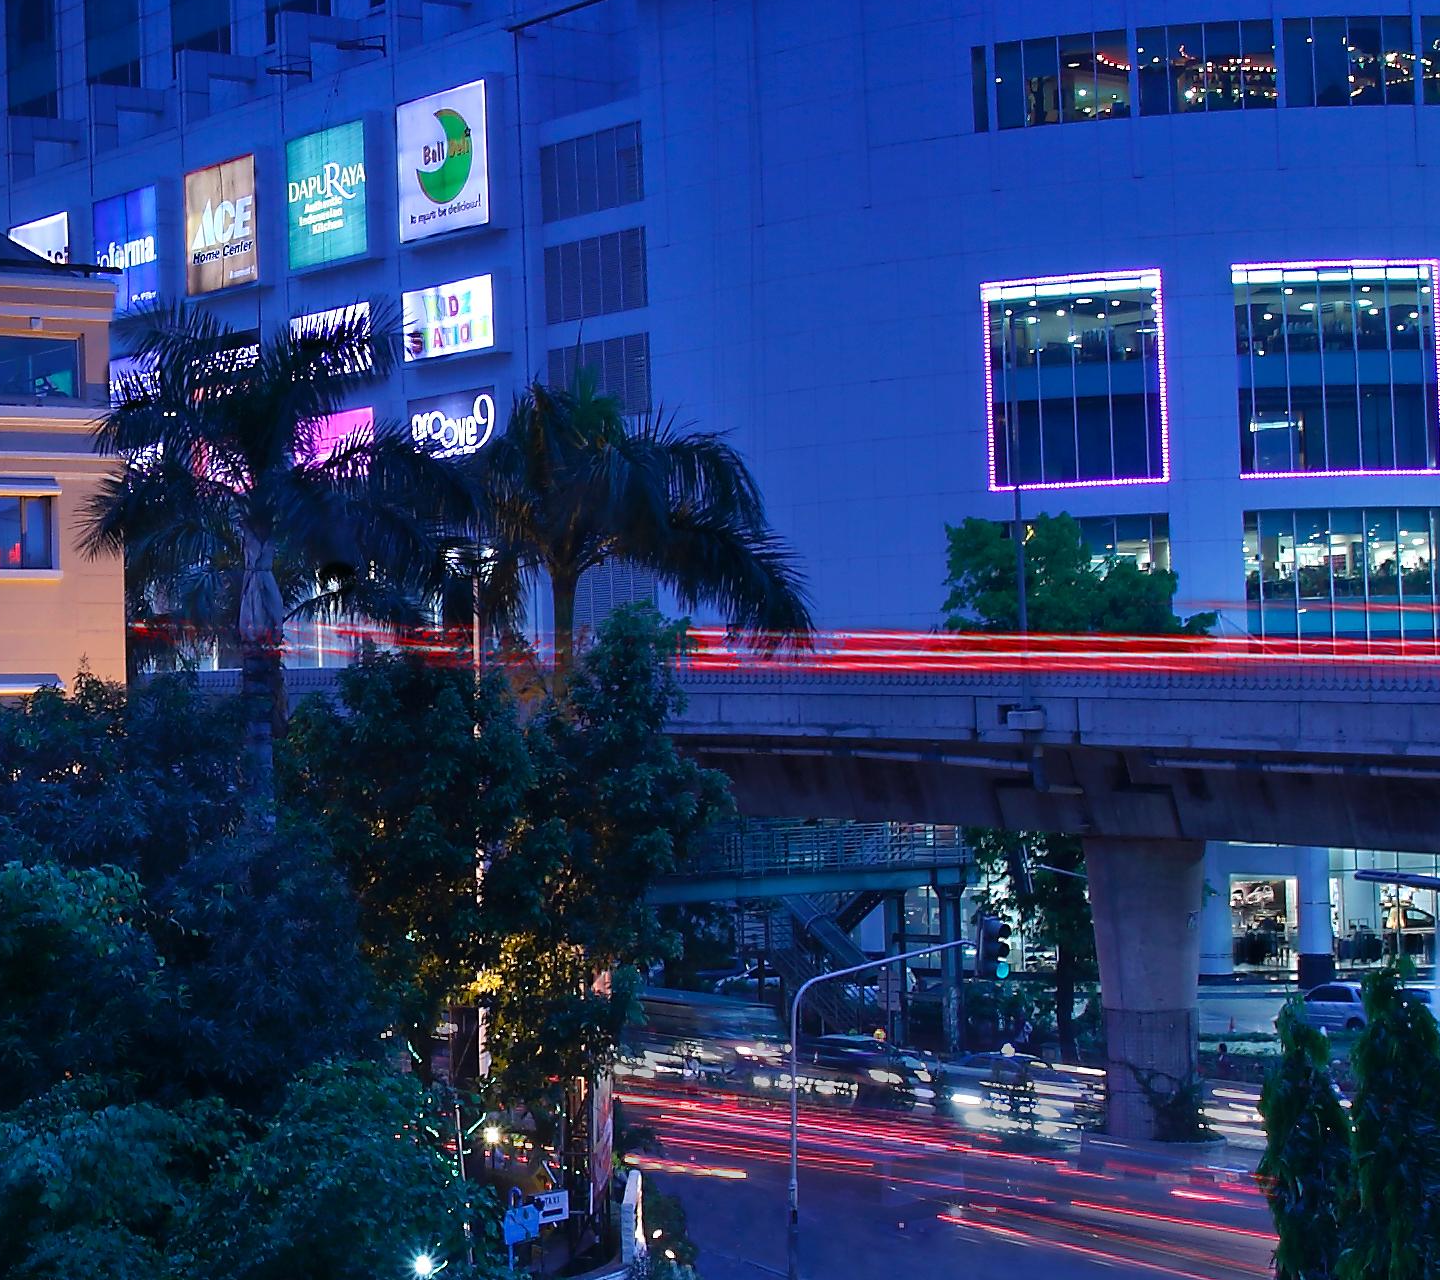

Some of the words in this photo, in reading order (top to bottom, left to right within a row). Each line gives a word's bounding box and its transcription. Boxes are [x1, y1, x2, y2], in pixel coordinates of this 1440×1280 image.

[288, 161, 367, 203] DAPURAYA
[191, 194, 253, 251] ACE
[192, 249, 221, 266] Home
[222, 240, 254, 259] Center
[422, 290, 472, 323] KIDZ
[411, 315, 490, 355] STATION
[544, 1195, 561, 1205] TAXI
